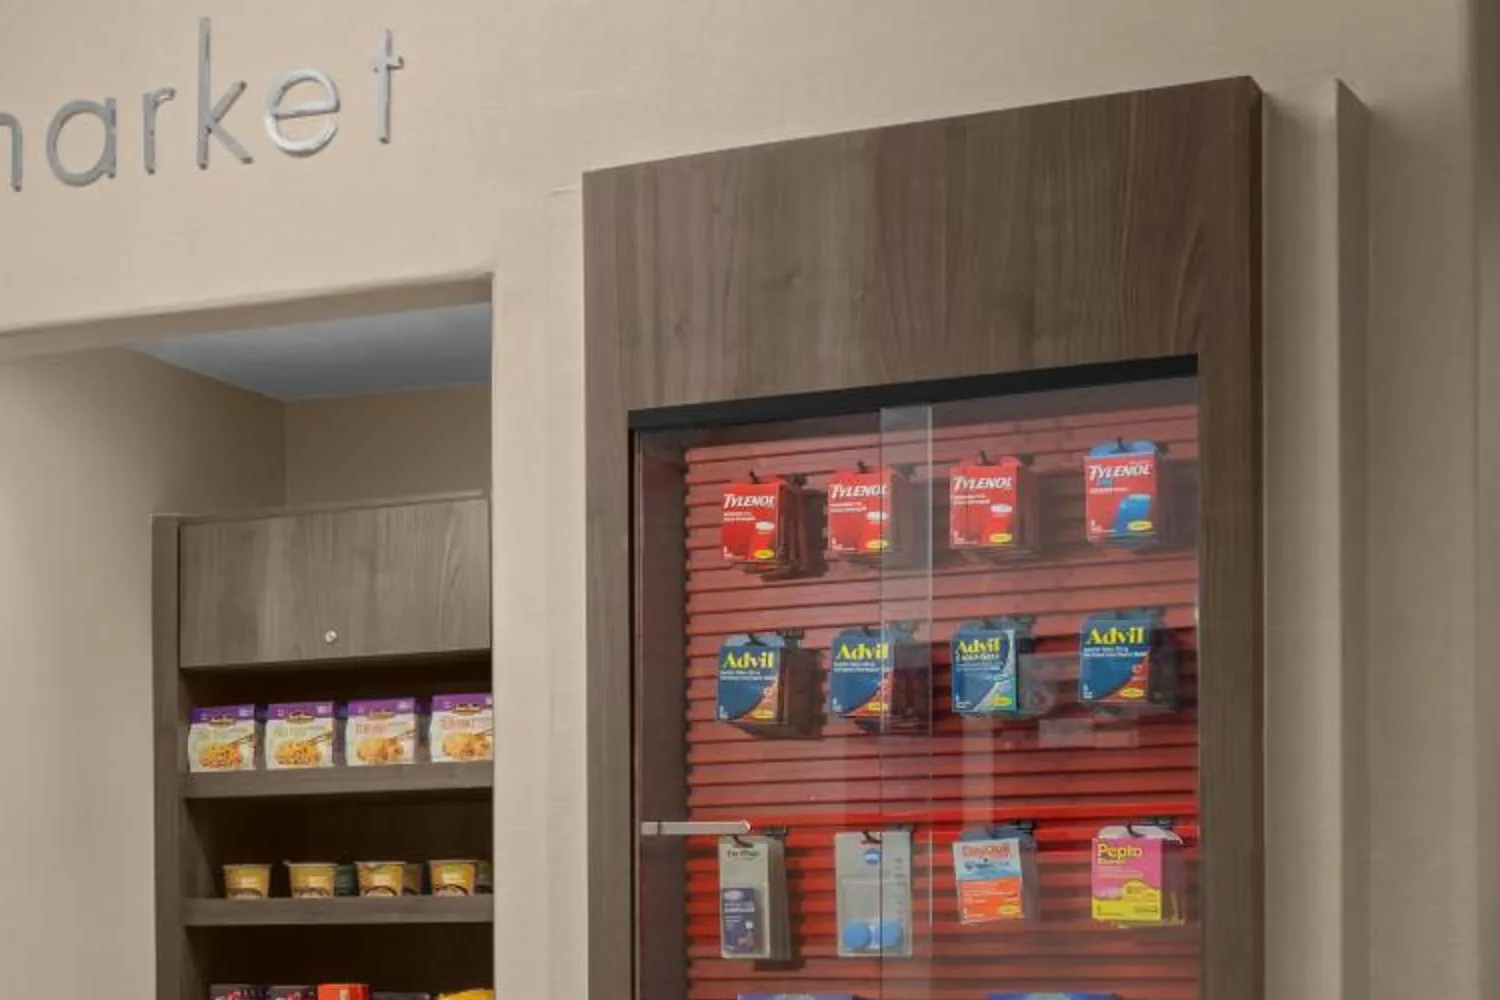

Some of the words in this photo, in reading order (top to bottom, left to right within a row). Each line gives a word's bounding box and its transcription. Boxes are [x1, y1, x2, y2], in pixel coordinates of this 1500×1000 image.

[1088, 463, 1153, 481] TYLENOL
[830, 483, 888, 499] TYLENOL
[954, 475, 1013, 492] TYLENOL
[723, 493, 776, 509] TYLENOL
[1084, 626, 1145, 645] Advil
[836, 642, 889, 660] Advil
[956, 637, 1001, 655] Advil
[723, 652, 775, 671] Advil
